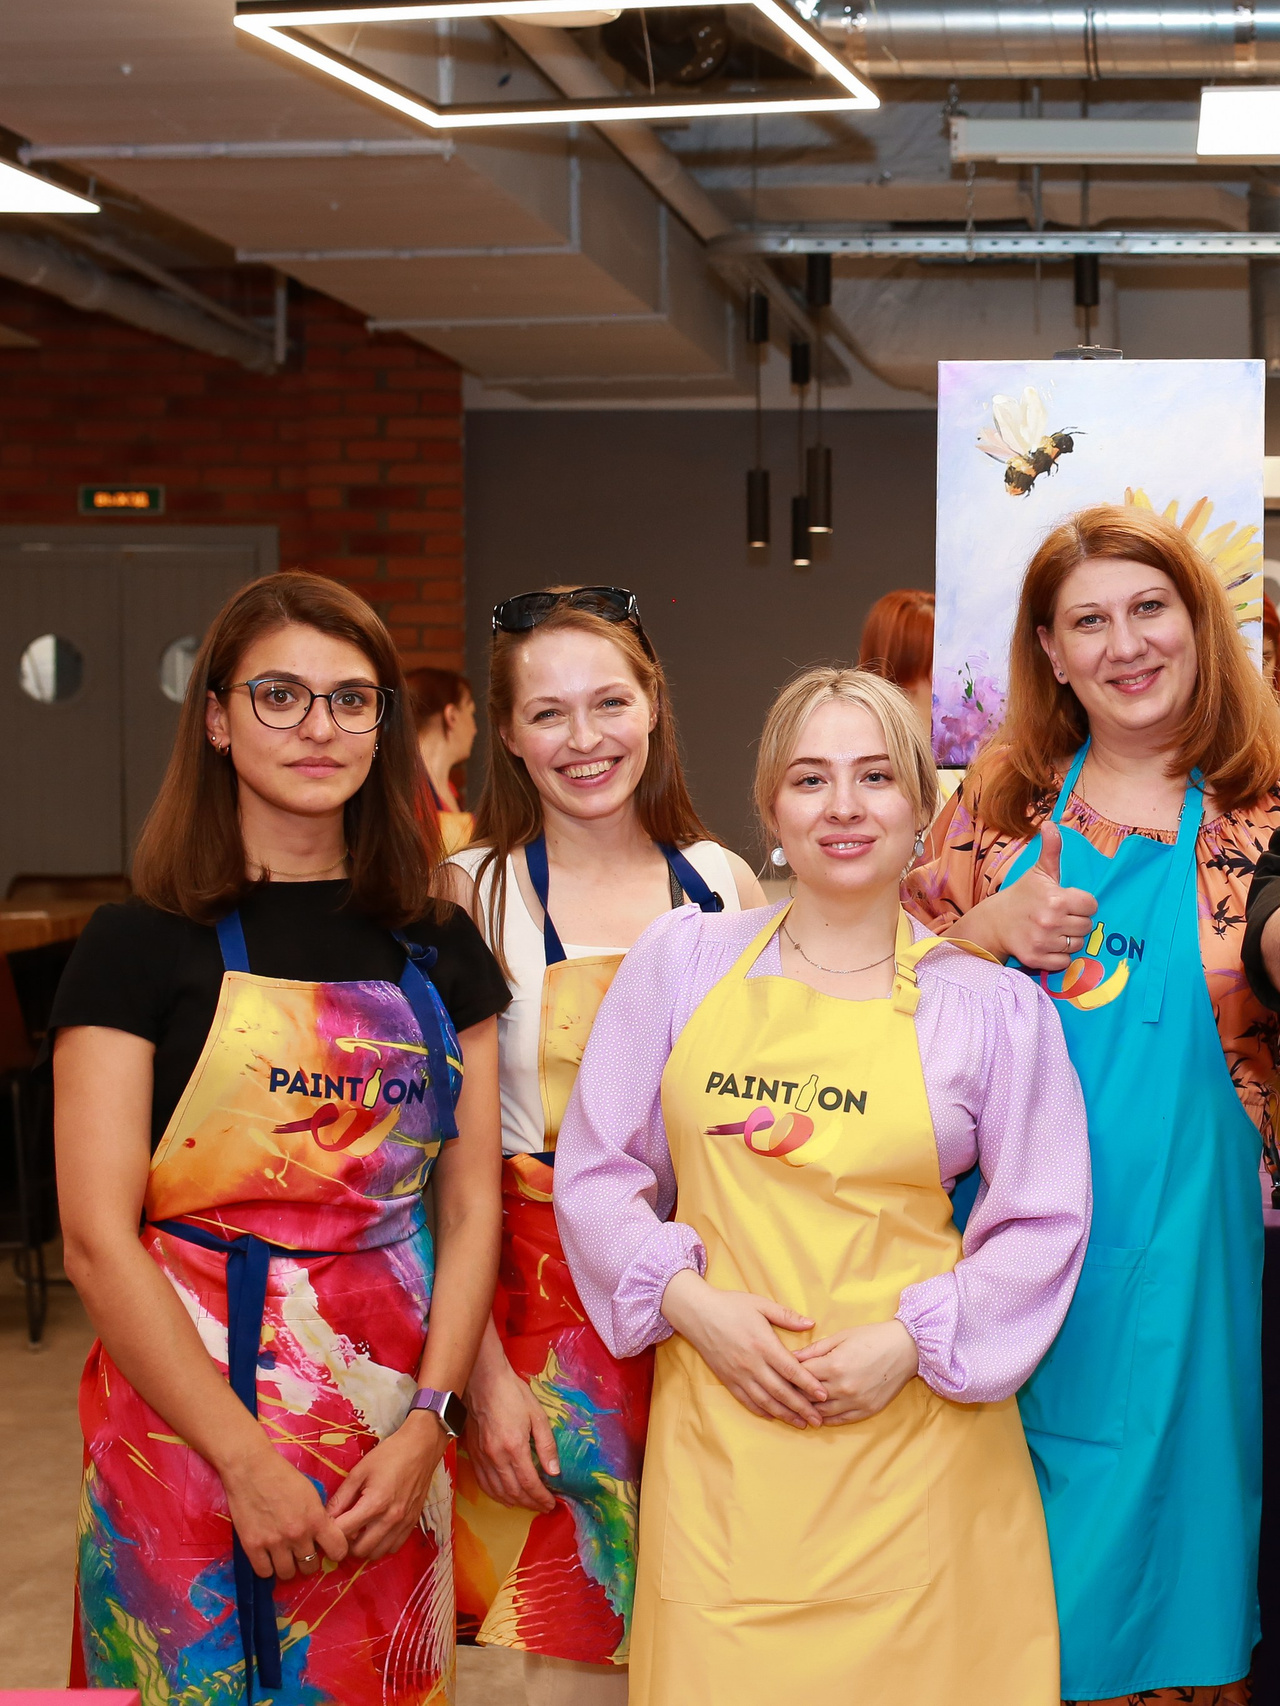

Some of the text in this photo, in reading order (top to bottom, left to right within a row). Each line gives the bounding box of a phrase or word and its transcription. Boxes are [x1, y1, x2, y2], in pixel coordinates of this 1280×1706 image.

[1105, 932, 1145, 963] ON
[269, 1067, 364, 1102] PAINT
[705, 1071, 799, 1105] PAINT
